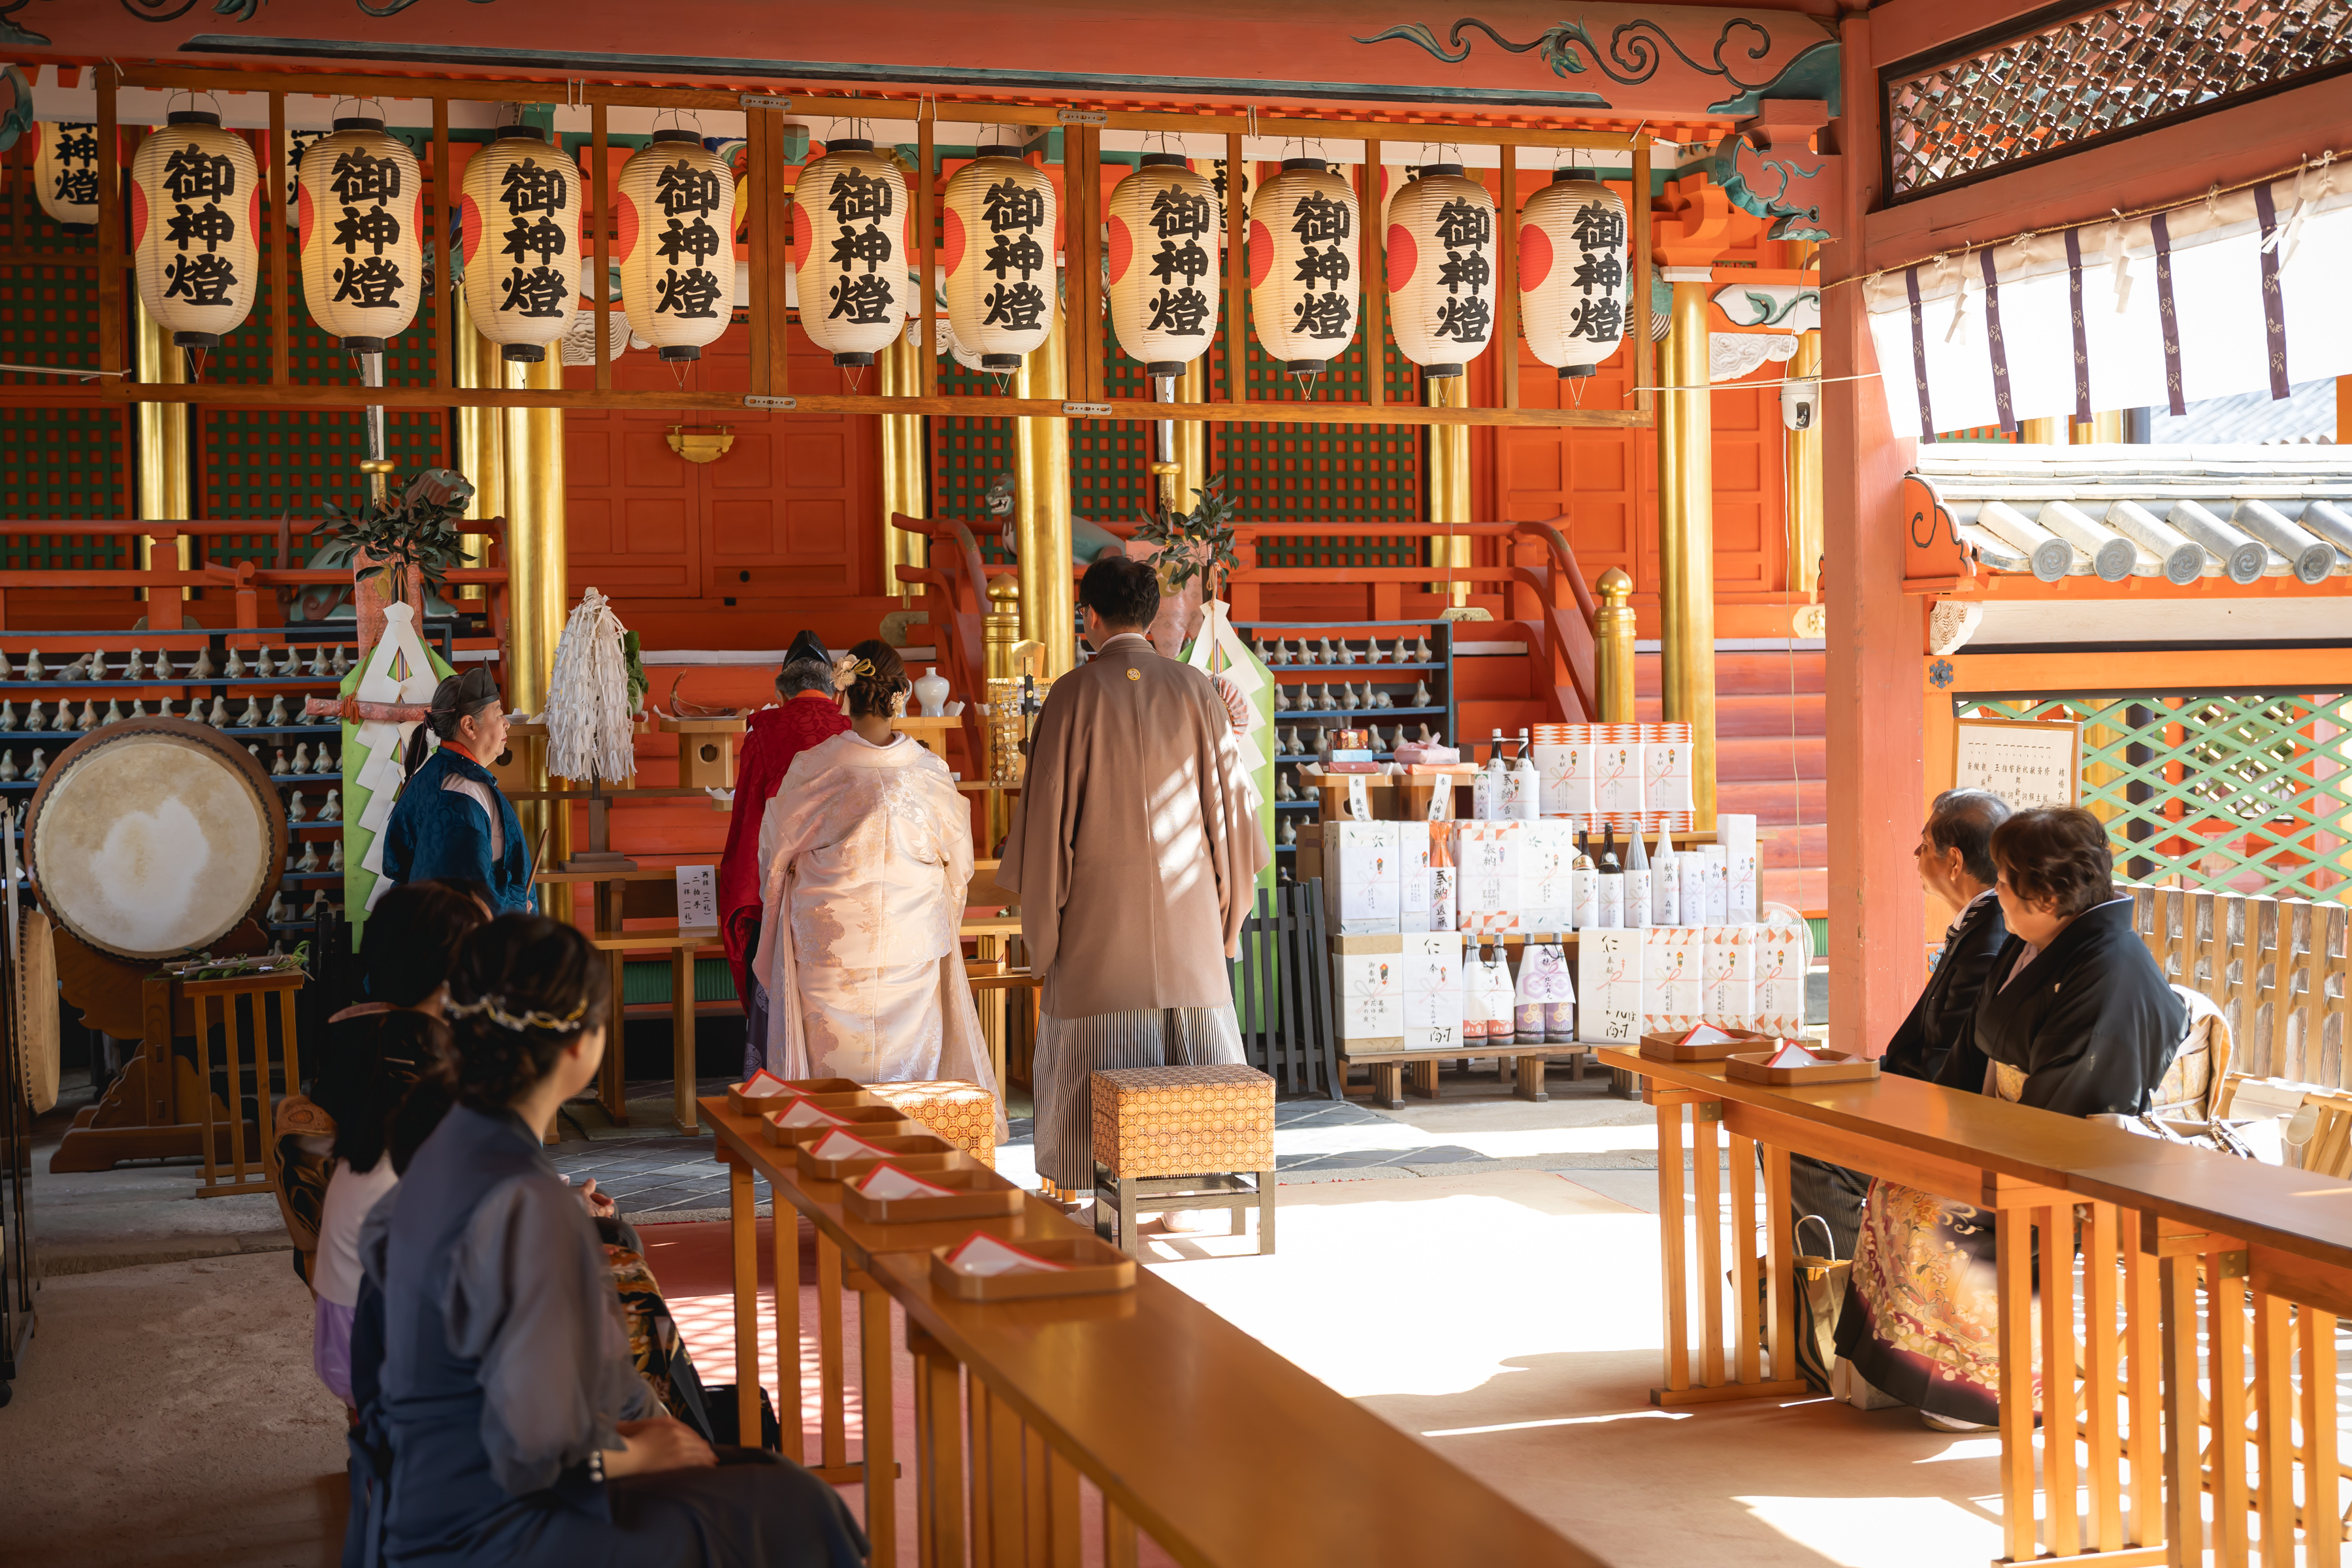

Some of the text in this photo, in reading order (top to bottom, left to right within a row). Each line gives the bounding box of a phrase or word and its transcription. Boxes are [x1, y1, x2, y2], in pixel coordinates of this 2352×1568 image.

[53, 122, 98, 204] 神燈
[164, 143, 238, 306] 御神燈
[331, 147, 404, 308] 御神燈
[500, 157, 569, 318] 御神燈
[655, 159, 722, 319] 御神燈
[828, 167, 894, 324] 御神燈
[982, 177, 1046, 331] 御神燈
[1147, 184, 1211, 336] 御神燈
[1292, 190, 1351, 339] 御神燈
[1435, 196, 1491, 343] 御神燈
[1569, 199, 1624, 343] 御神燈
[693, 876, 701, 909] 二拍手
[1434, 870, 1447, 900] 奉納
[1664, 863, 1673, 882] 献酒
[1606, 956, 1615, 975] 奉献
